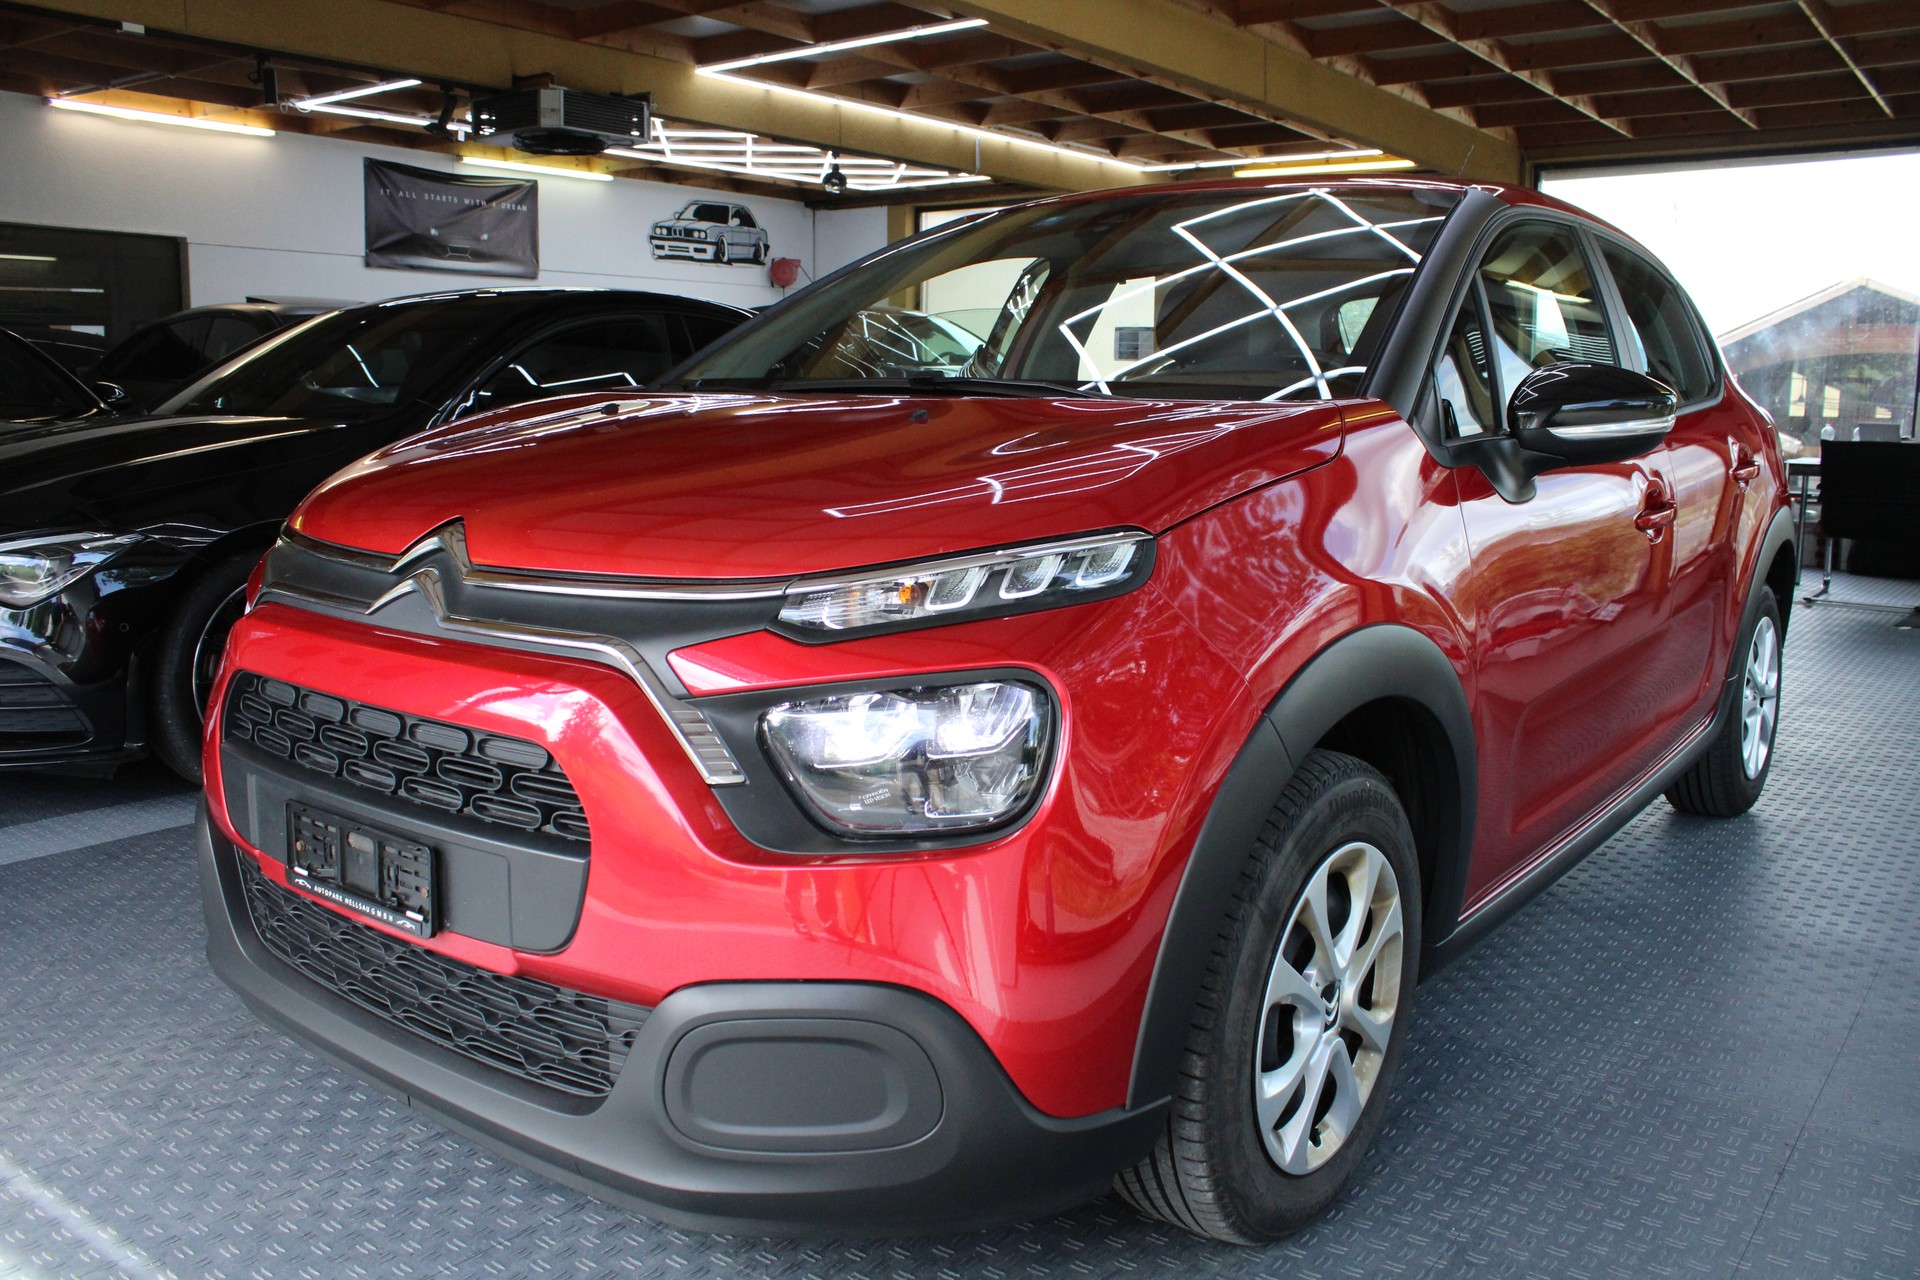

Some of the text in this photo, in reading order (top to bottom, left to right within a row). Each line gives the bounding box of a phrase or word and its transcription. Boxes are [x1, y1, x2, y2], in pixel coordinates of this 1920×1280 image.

[380, 187, 391, 196] IT
[398, 190, 417, 199] ALL
[424, 193, 458, 204] STARTS
[463, 198, 487, 206] WITH
[501, 202, 528, 212] DREAM
[314, 885, 343, 902] AUTOPARK
[344, 898, 370, 913] HELLSAU
